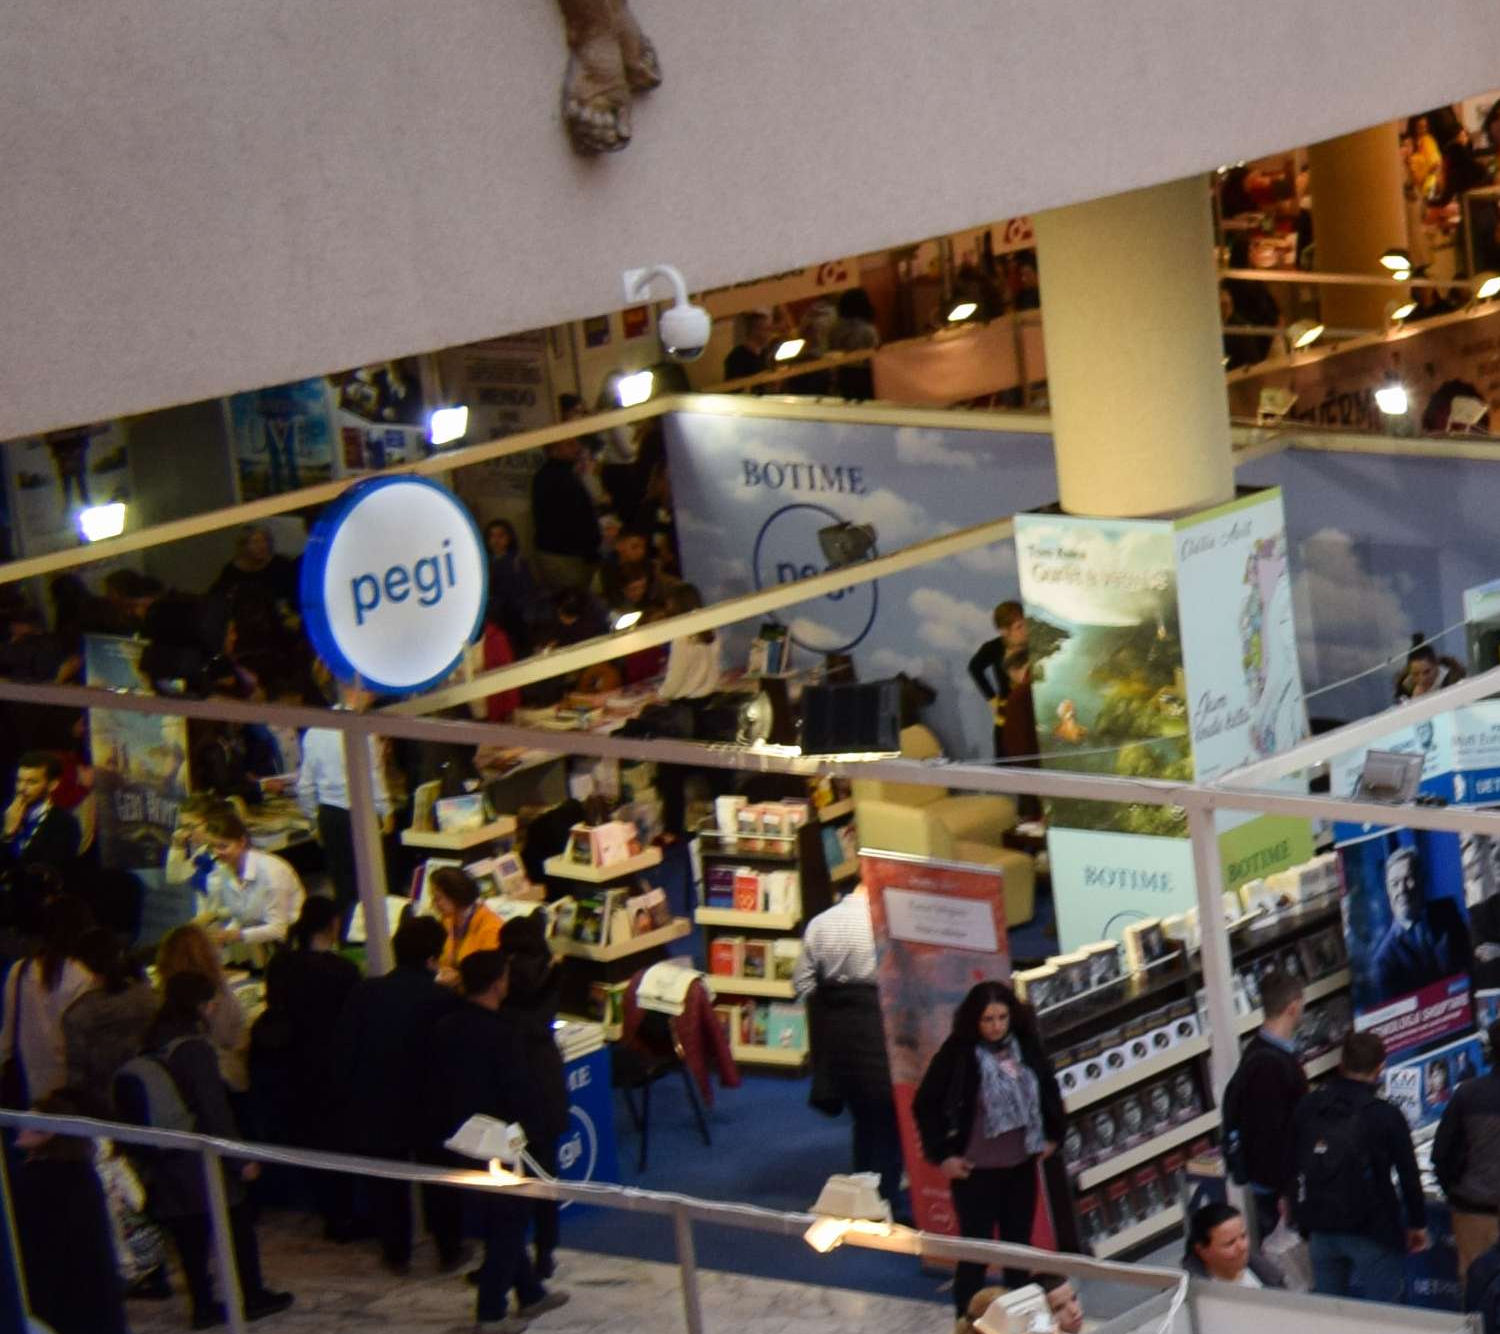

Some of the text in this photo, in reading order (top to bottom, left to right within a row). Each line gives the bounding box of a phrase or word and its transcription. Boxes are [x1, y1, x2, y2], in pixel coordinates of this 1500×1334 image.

[743, 458, 866, 495] BOTIME
[350, 539, 459, 625] pegi
[1084, 865, 1174, 893] BOTIME
